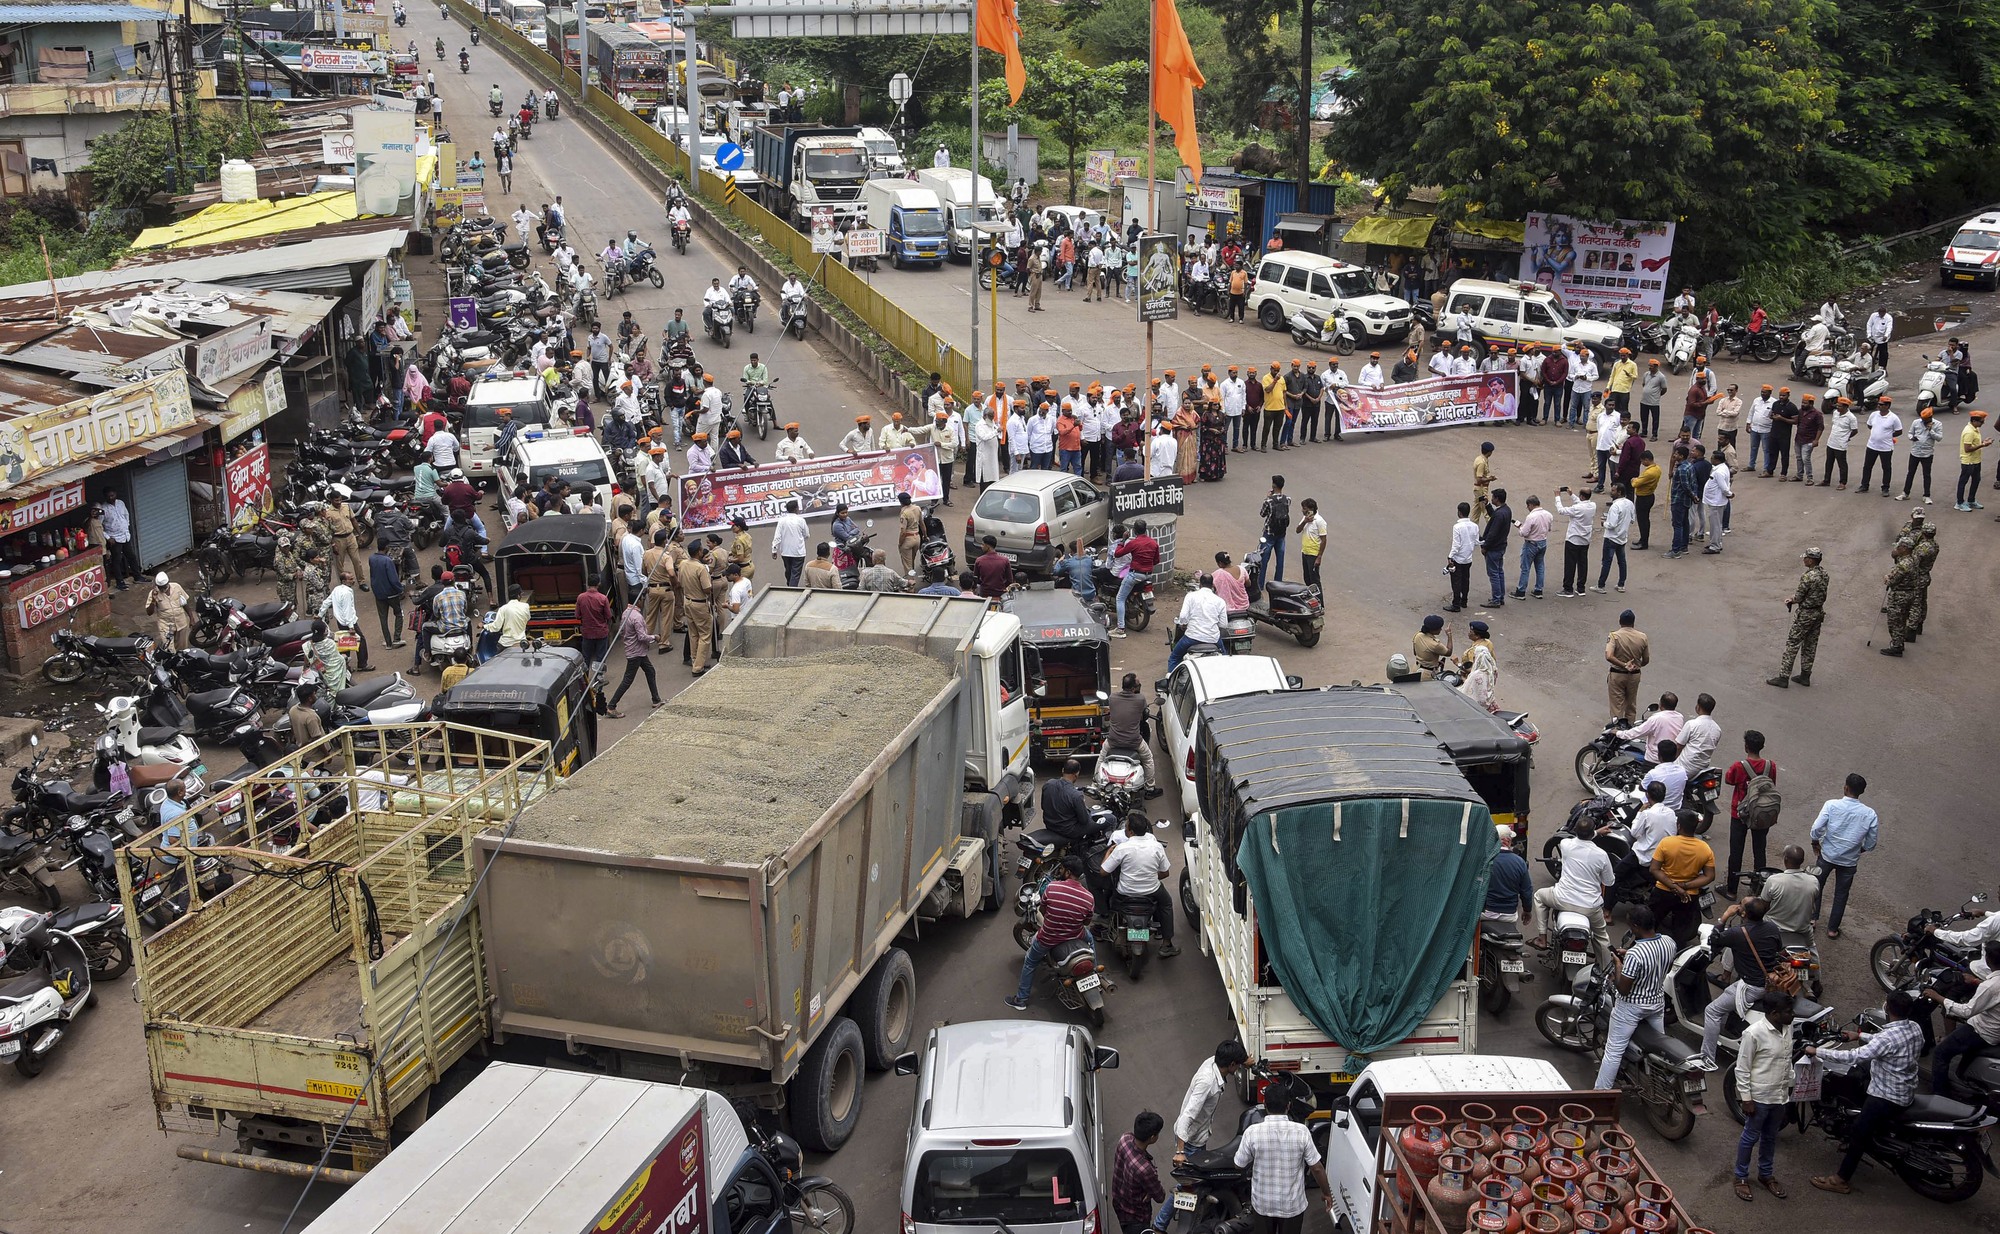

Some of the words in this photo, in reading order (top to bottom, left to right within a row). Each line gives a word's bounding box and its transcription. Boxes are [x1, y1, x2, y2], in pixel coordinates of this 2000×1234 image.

[382, 143, 402, 151] मसाला
[1372, 411, 1395, 425] रस्ता
[1395, 408, 1420, 424] रोको
[1435, 402, 1477, 420] आंदोलन
[29, 394, 157, 467] चायनिज
[558, 467, 577, 476] POLICE
[743, 483, 768, 495] सकल
[769, 480, 794, 492] मराठा
[796, 475, 821, 487] समाज
[823, 471, 844, 484] कराड
[846, 469, 873, 482] तालुका
[12, 486, 83, 528] चायनिज
[725, 501, 762, 521] रस्ता
[827, 483, 895, 506] आंदोलन
[1115, 489, 1147, 512] संभाजी
[1148, 486, 1165, 507] राजे
[1165, 484, 1184, 504] चौक
[1056, 627, 1090, 638] KARAD
[335, 1061, 359, 1071] 7242
[1052, 1176, 1071, 1204] L
